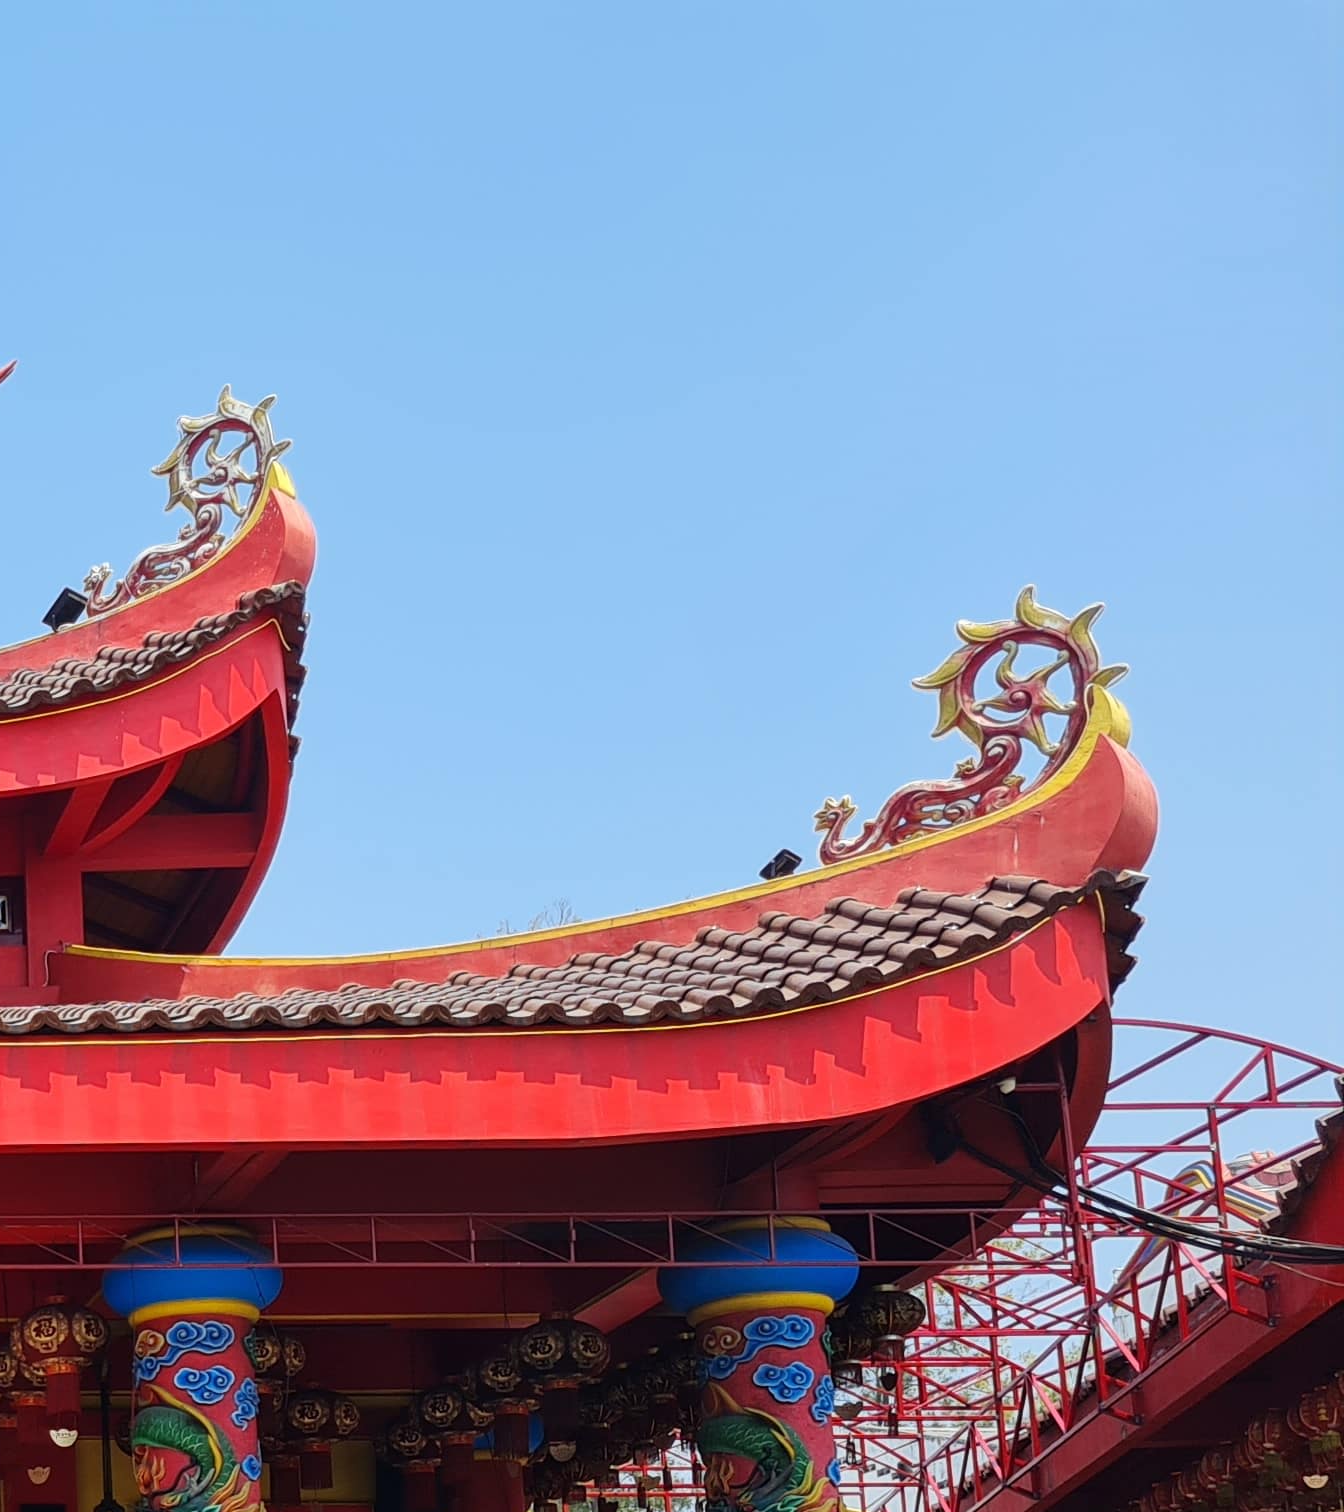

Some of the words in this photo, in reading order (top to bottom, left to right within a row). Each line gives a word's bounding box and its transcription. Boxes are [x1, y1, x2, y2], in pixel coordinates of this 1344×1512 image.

[33, 1318, 57, 1338] 福
[530, 1335, 554, 1357] 福
[429, 1395, 450, 1417] 福
